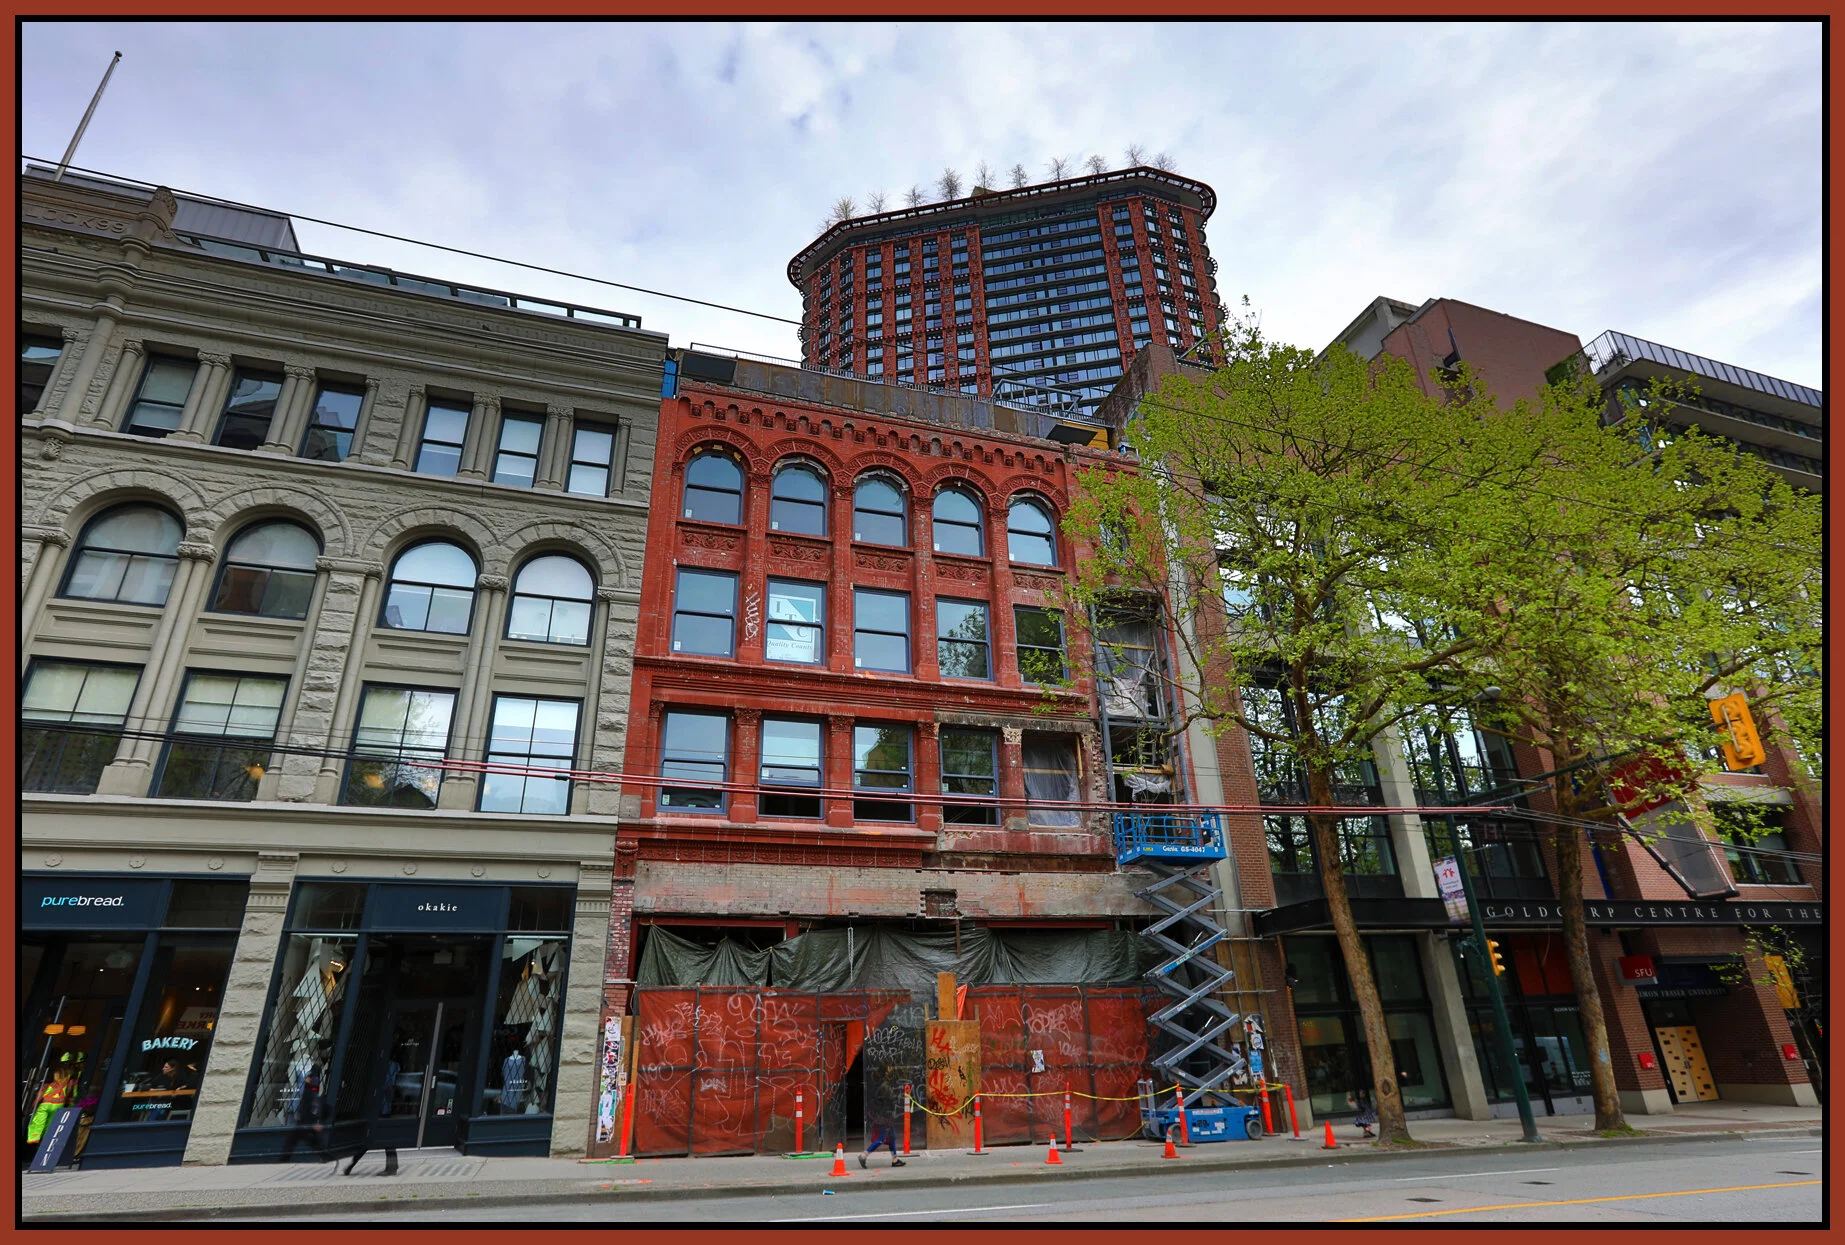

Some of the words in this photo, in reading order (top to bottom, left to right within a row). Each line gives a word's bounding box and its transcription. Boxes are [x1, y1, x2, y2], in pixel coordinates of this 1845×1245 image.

[41, 895, 125, 908] purebread.
[1485, 905, 1616, 919] GOLDCRP
[1634, 906, 1719, 919] CENTRE
[1734, 907, 1772, 919] FOR
[1785, 908, 1822, 919] THE
[1634, 968, 1653, 978] SFU
[141, 1036, 199, 1053] BAKERY
[40, 1110, 71, 1167] OPEN
